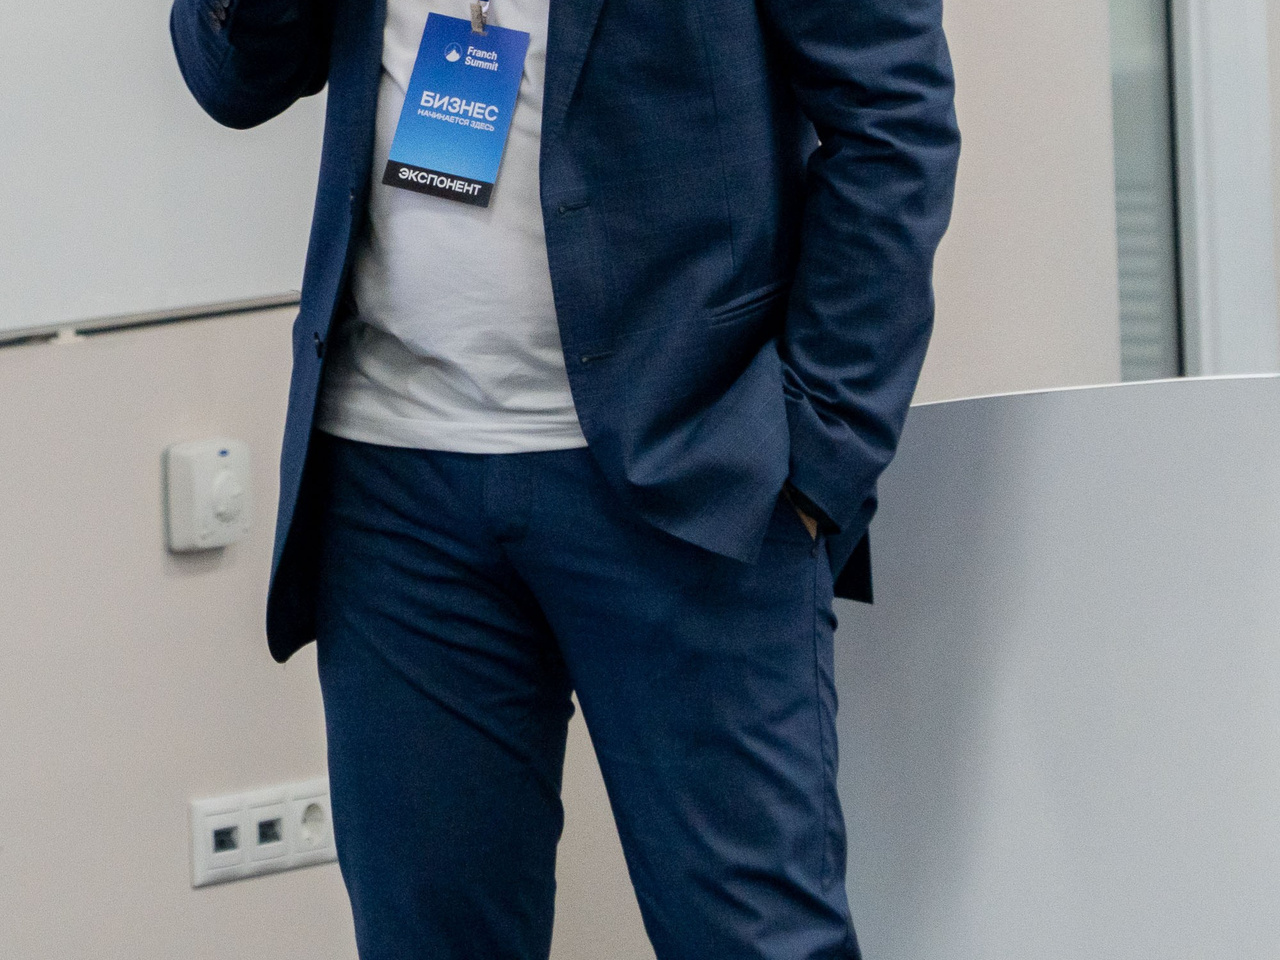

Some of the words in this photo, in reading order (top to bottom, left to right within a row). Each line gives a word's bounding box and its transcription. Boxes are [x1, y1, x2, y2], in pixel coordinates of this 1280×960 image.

[464, 56, 499, 71] Summit
[467, 46, 498, 61] Franch
[420, 91, 499, 121] БИЗНЕС
[417, 109, 470, 126] НАЧИНАЕТСЯ
[470, 120, 495, 132] ЗДЕСЬ
[398, 167, 482, 196] ЭКСПОНЕНТ
